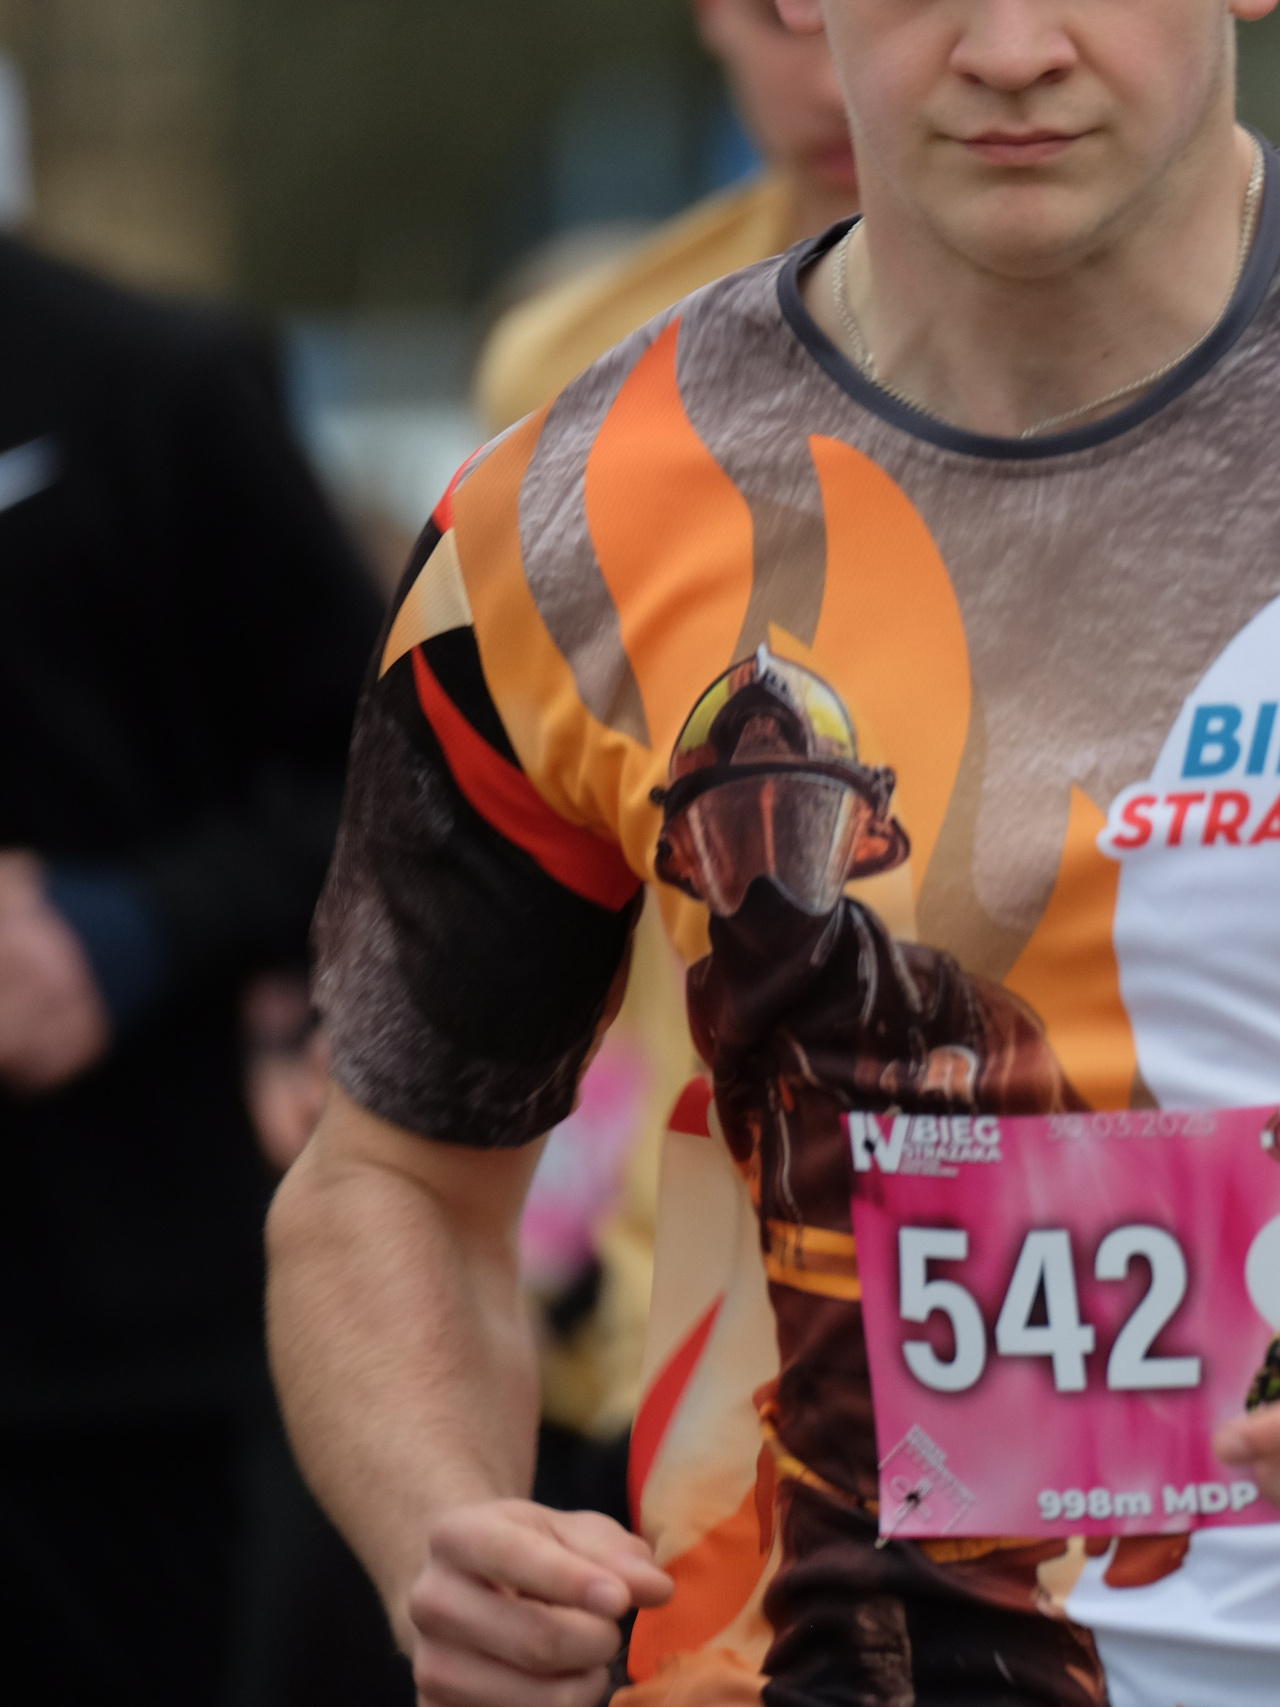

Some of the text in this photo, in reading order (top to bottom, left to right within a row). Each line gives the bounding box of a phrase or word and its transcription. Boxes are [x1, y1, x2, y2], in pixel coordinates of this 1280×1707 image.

[911, 1114, 1000, 1145] BIEG
[899, 1224, 1201, 1392] 542
[1038, 1481, 1259, 1521] 998m MDP
